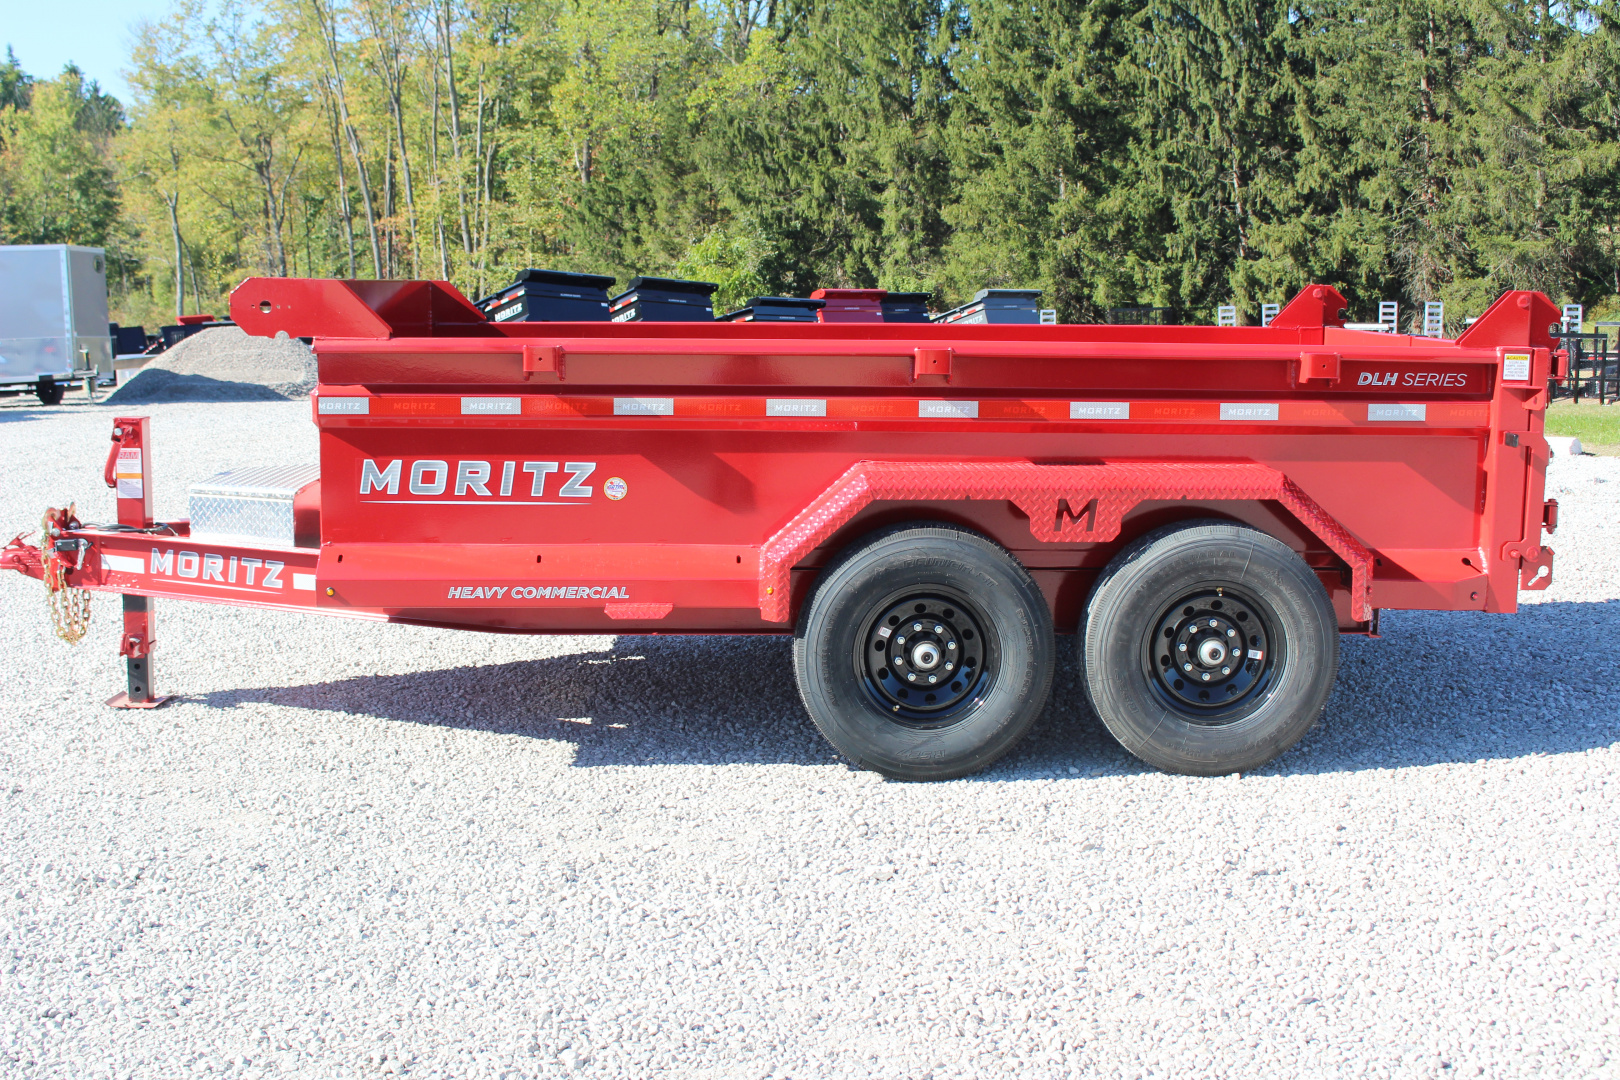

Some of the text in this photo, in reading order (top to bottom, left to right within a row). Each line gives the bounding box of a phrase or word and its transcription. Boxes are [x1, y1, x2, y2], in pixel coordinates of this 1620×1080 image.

[494, 302, 522, 322] MORITZ
[1357, 372, 1468, 387] DLH SERIES
[319, 402, 1490, 417] MORITZ MORITZ MORITZ MORITZ MORITZ MORITZ MORITZ MORITZ MORITZ MORITZ MORITZ MORITZ MORITZ MORITZ MORITZ MORITZ
[359, 459, 597, 498] MORITZ
[1053, 498, 1098, 532] M
[150, 548, 285, 589] MORITZ
[448, 587, 630, 599] HEAVY COMMERCIAL
